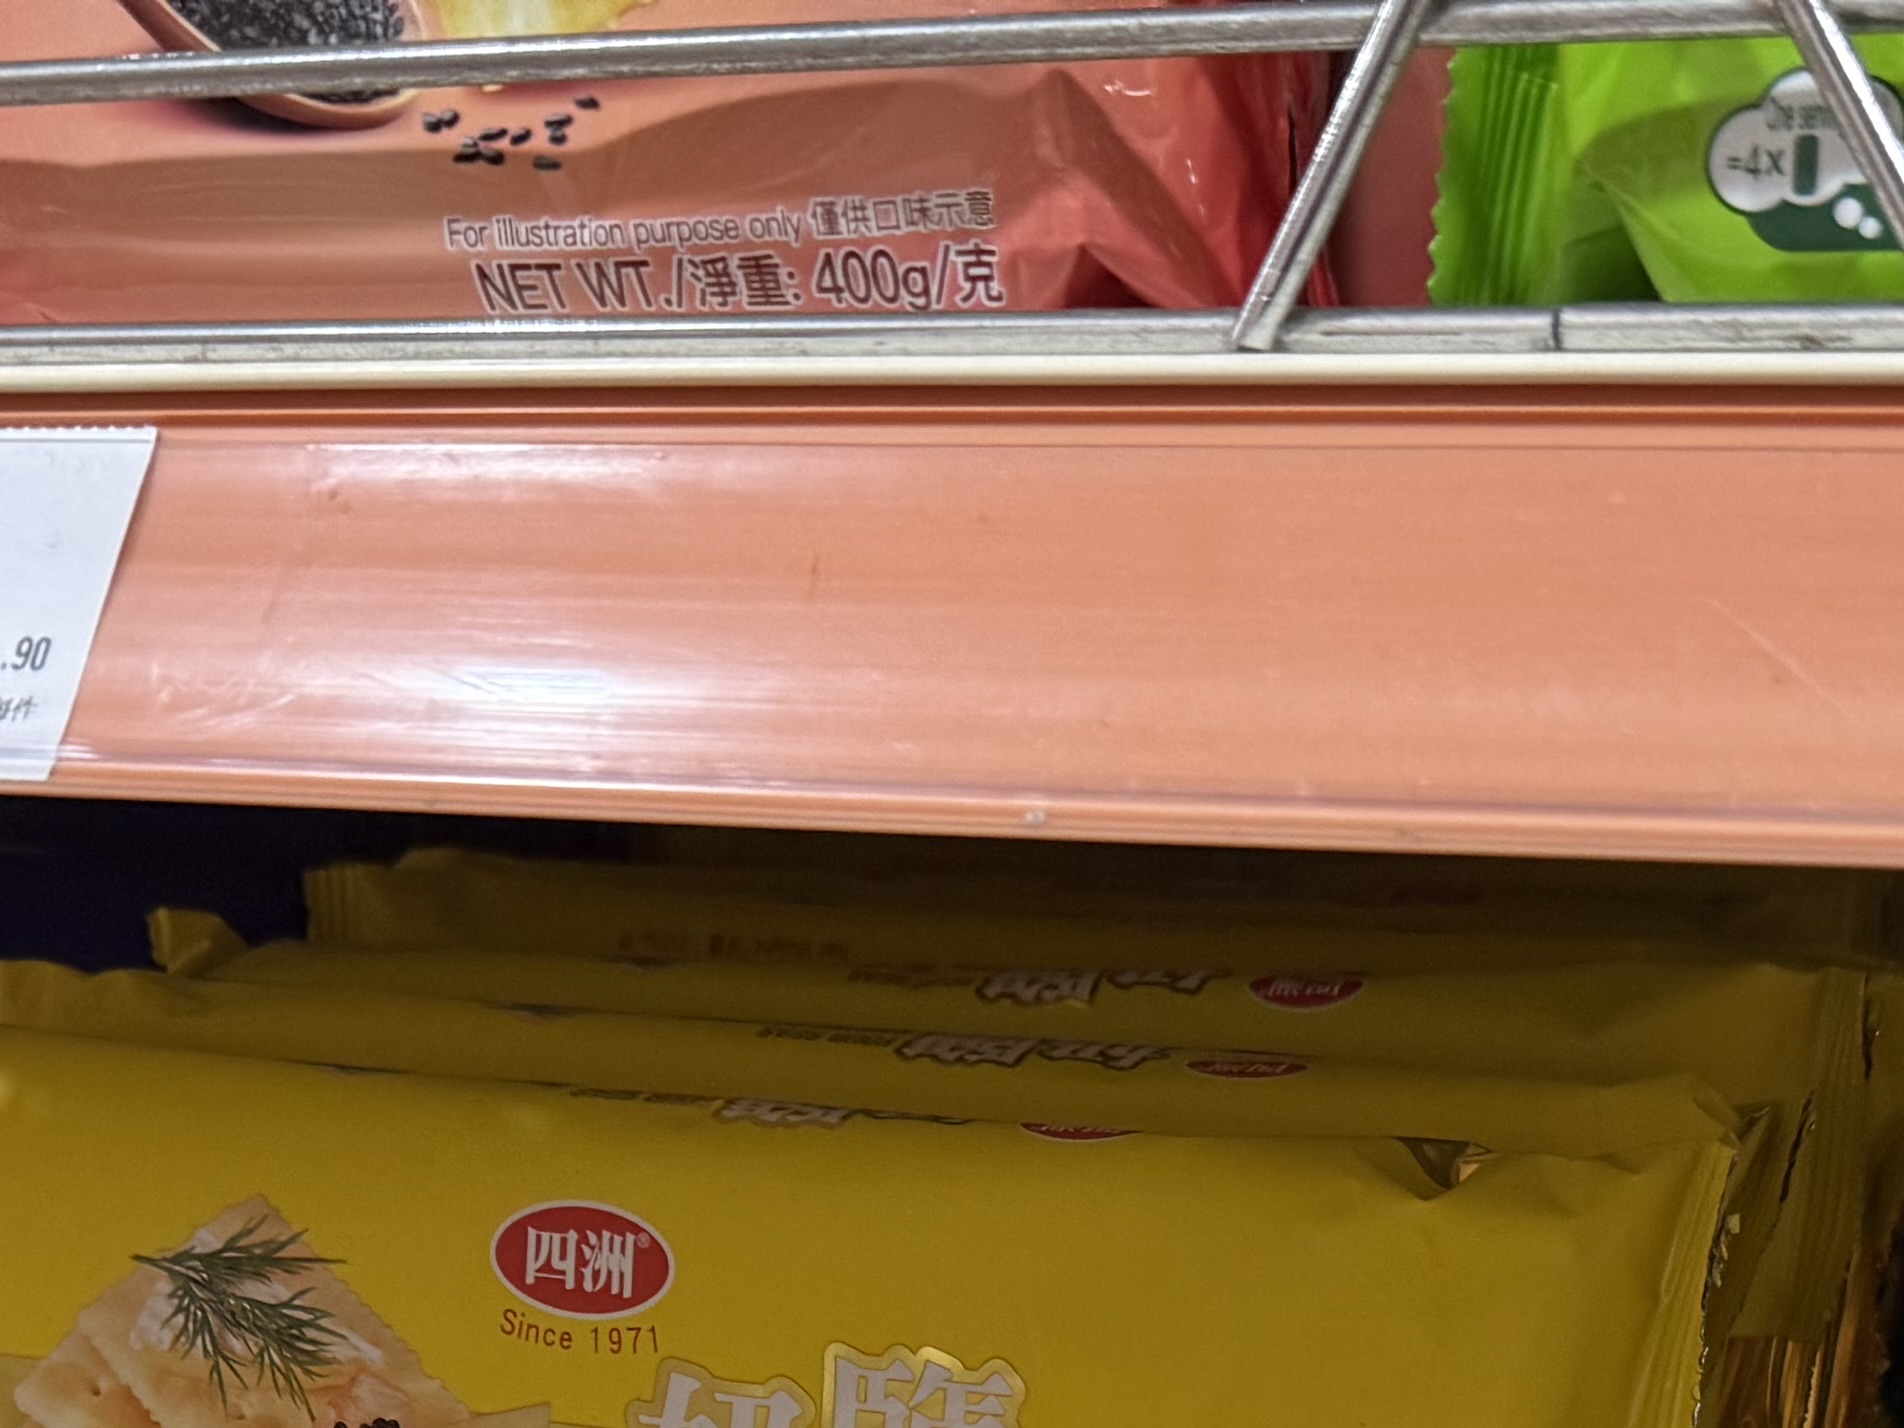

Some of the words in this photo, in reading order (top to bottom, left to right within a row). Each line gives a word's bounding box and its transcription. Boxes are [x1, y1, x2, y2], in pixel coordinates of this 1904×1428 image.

[446, 218, 490, 250] For
[496, 216, 629, 250] illustration
[632, 217, 741, 252] purpose
[748, 206, 803, 245] only
[809, 190, 996, 238] 僅供口味示意
[474, 262, 568, 313] NET
[814, 242, 1005, 313] 400g/克
[525, 1226, 637, 1300] 四洲
[499, 1307, 574, 1353] Since
[590, 1324, 661, 1356] 1971
